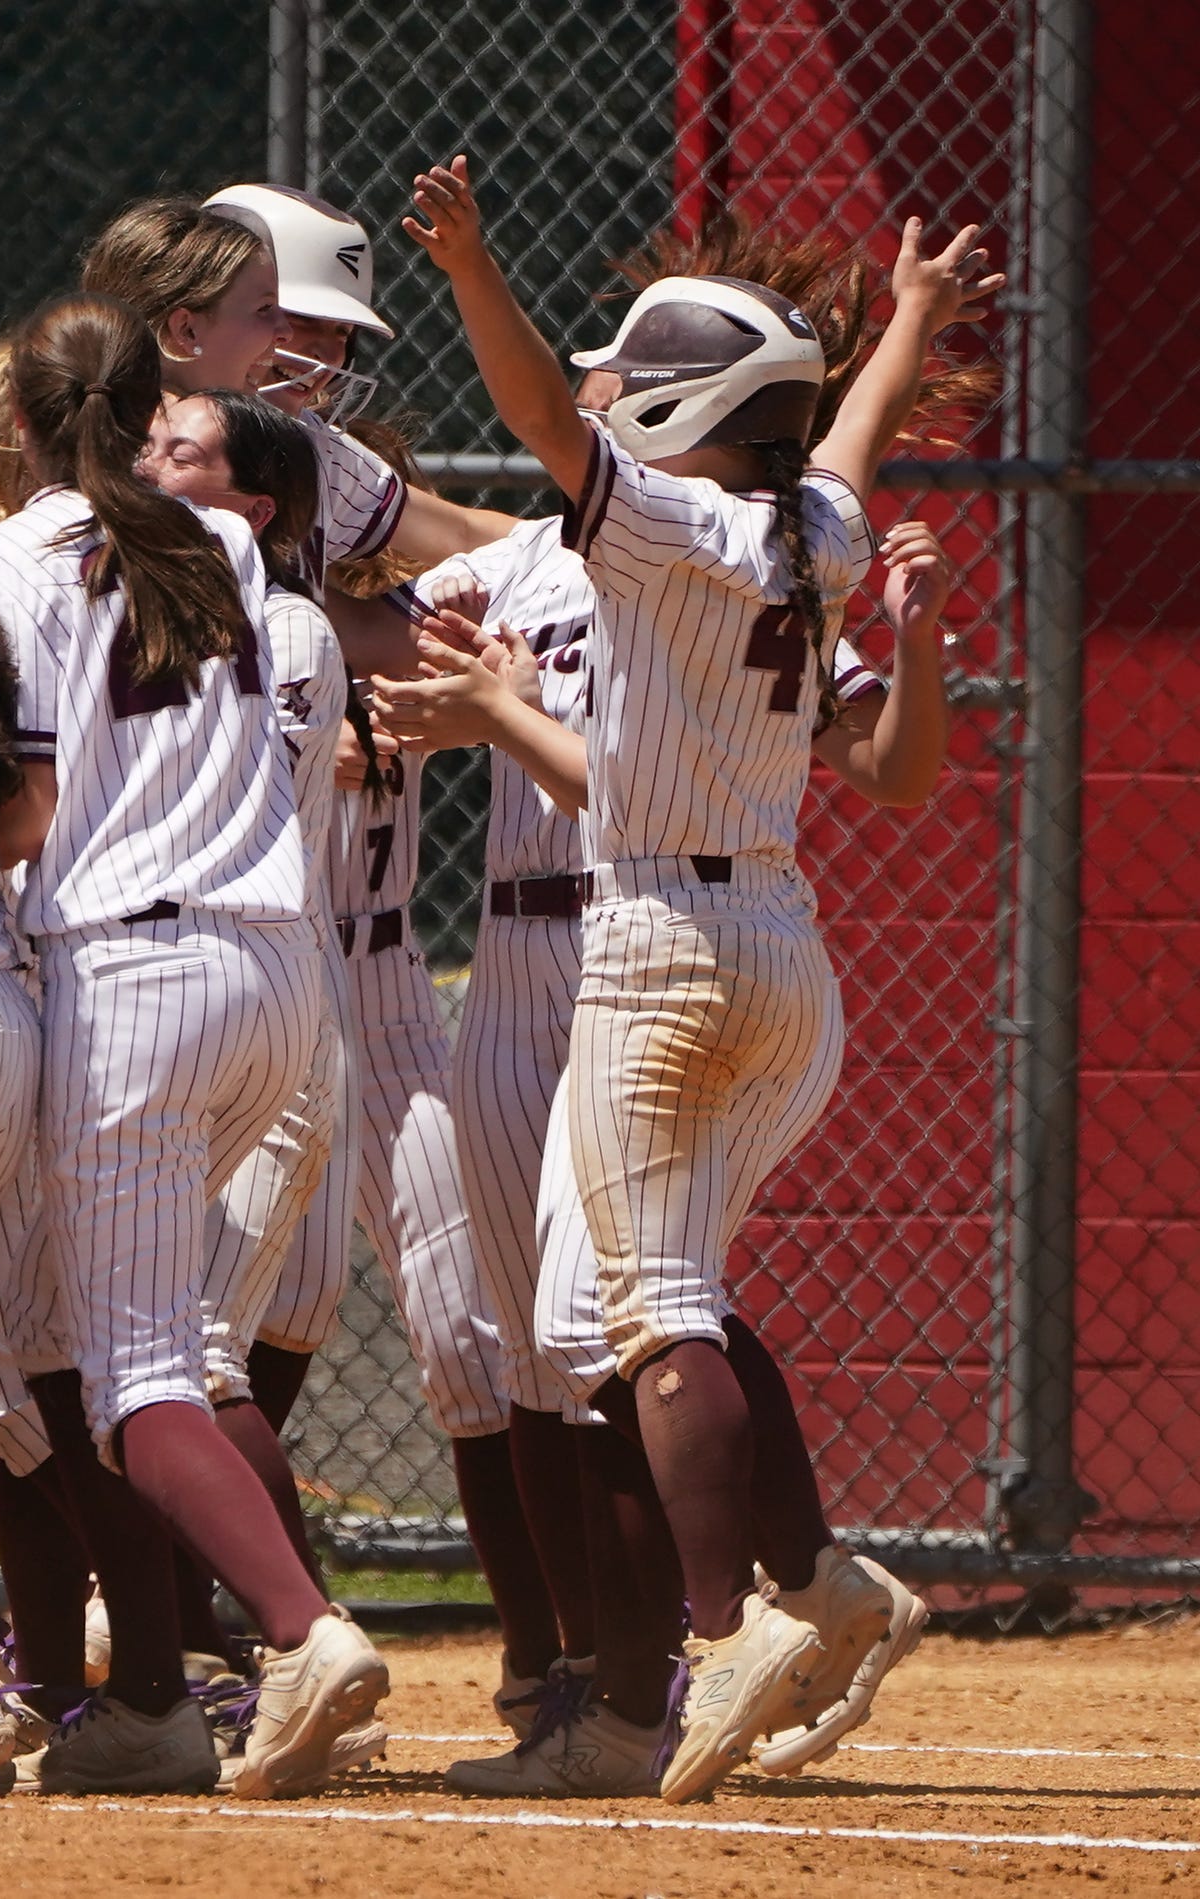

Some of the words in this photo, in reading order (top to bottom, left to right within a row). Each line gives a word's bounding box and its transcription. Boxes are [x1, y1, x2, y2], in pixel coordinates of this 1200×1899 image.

[630, 369, 676, 378] EASTON
[744, 604, 808, 714] 4
[367, 824, 394, 888] 7
